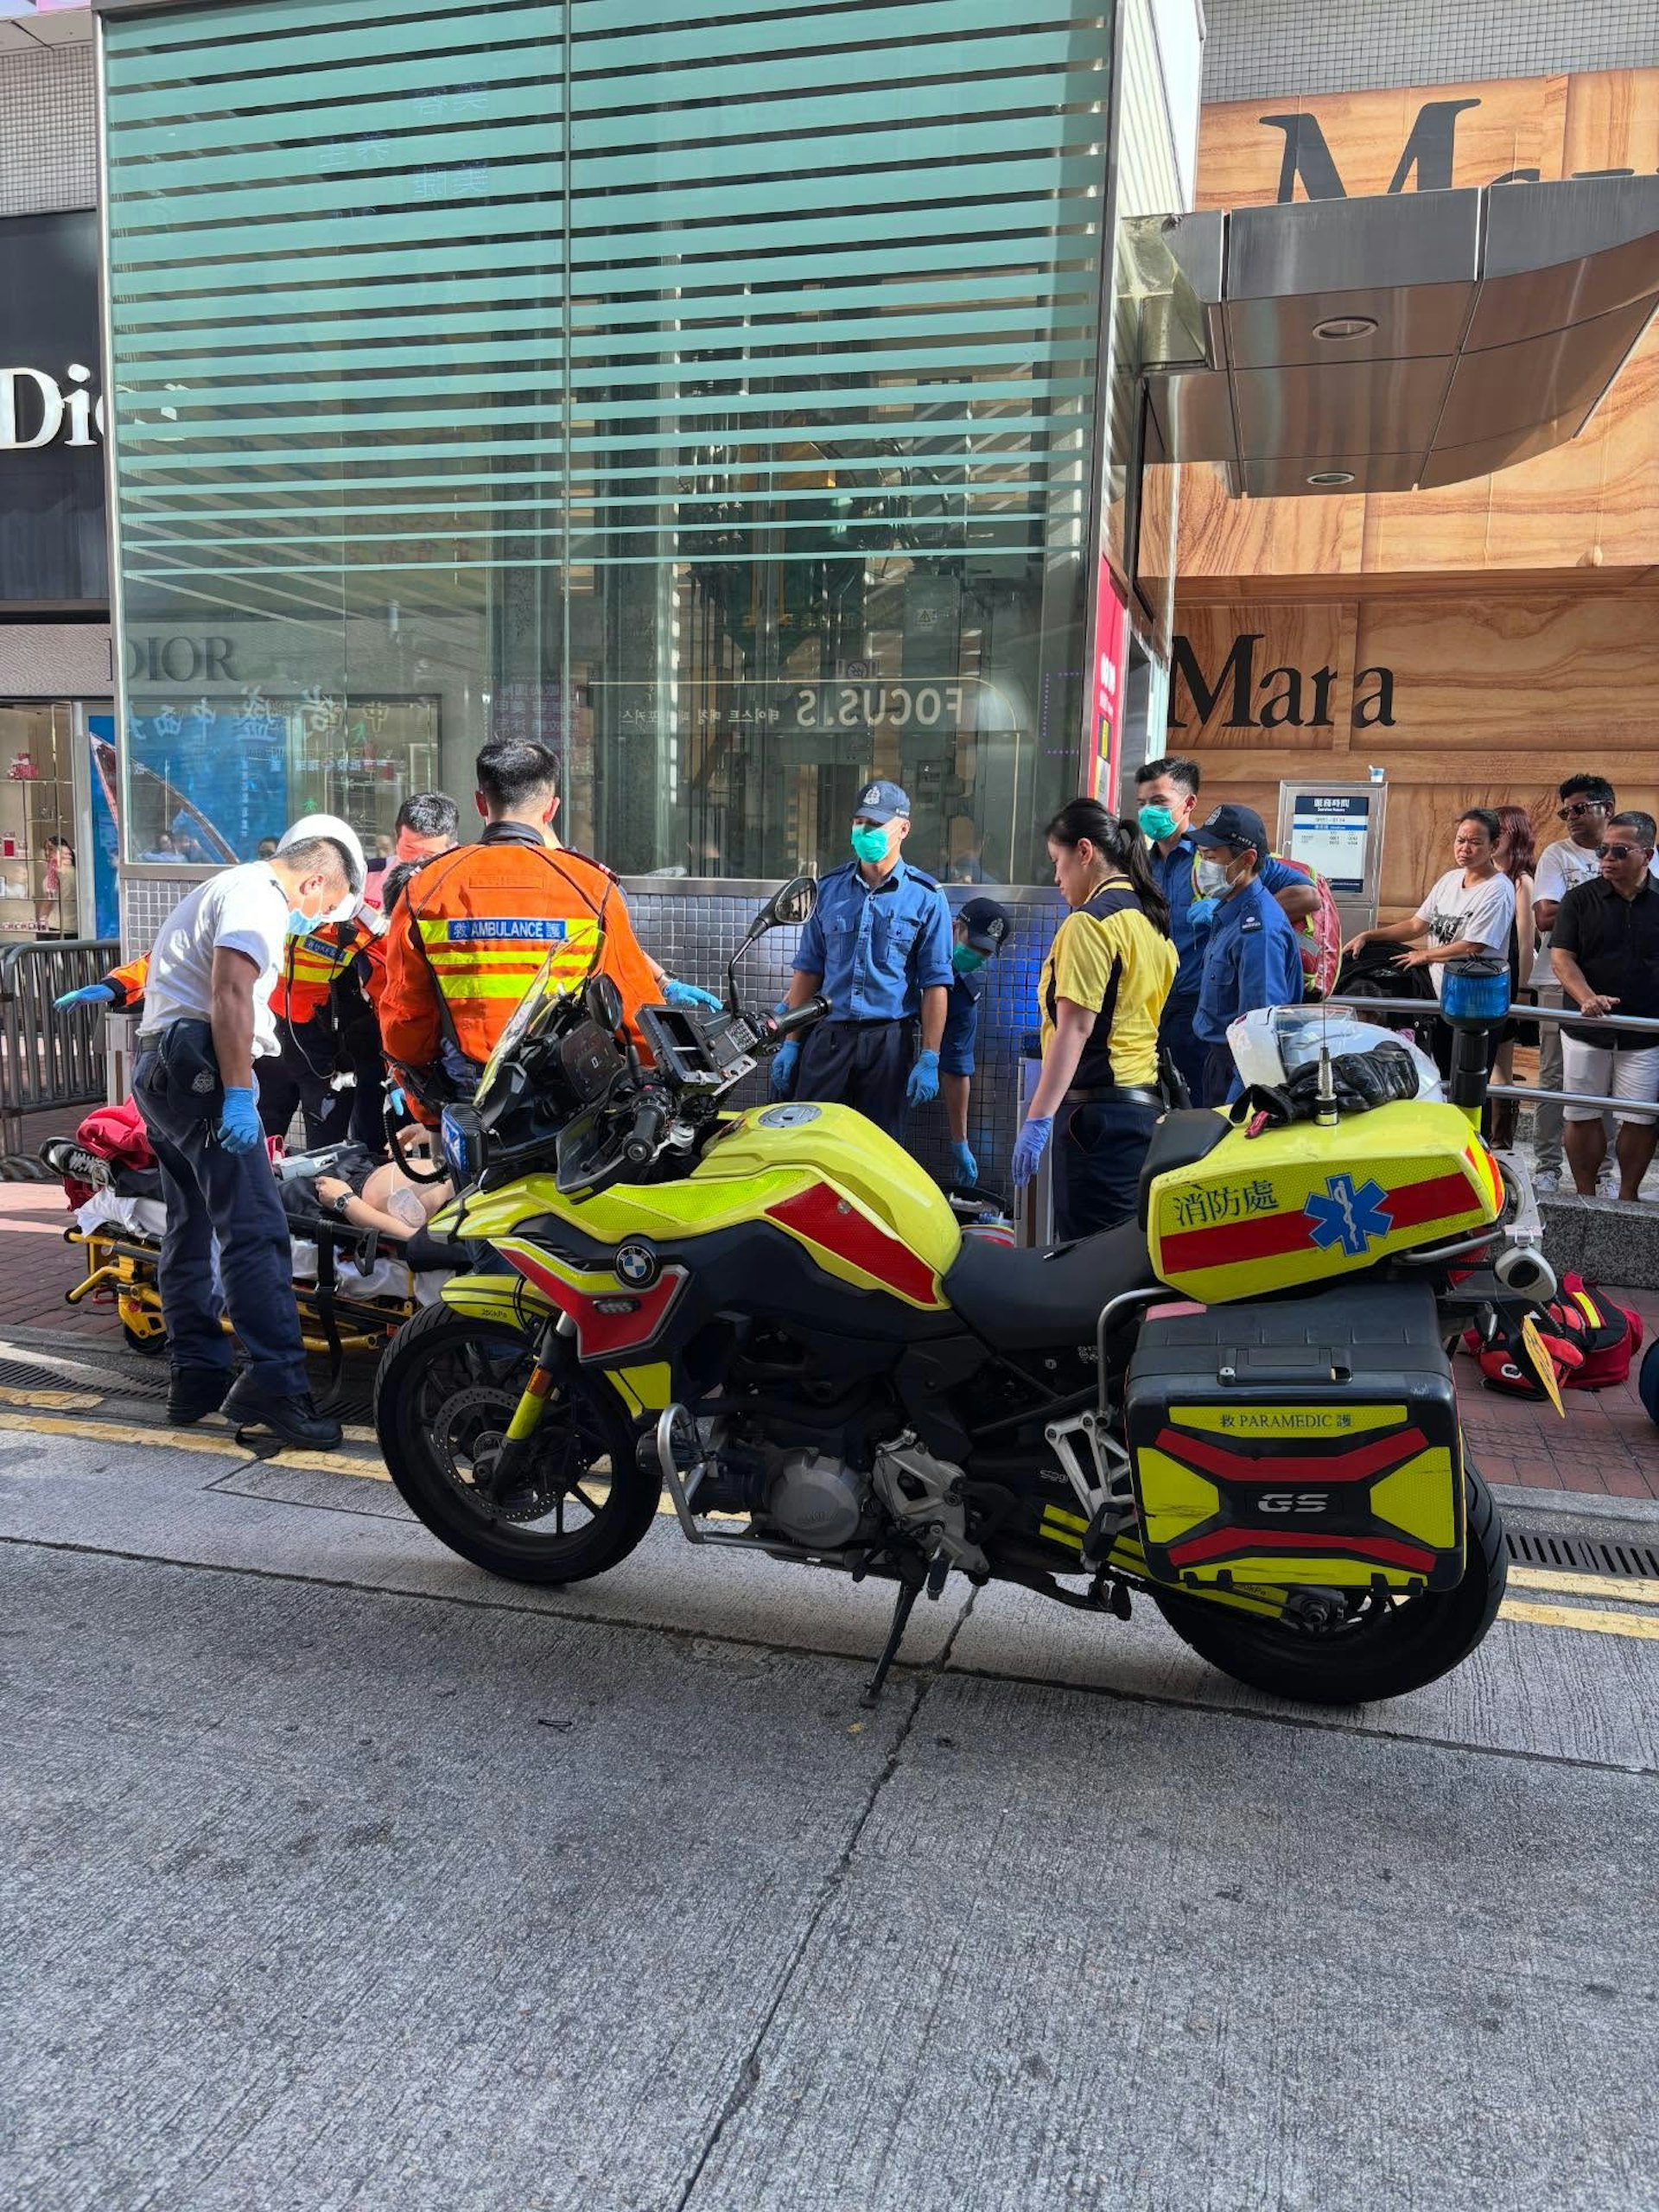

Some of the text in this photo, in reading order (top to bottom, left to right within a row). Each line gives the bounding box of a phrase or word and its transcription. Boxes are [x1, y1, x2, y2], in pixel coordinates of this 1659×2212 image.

[1166, 634, 1396, 728] Mara
[454, 921, 561, 938] 救 AMBULANCE 護
[1173, 1179, 1280, 1226] 消防處
[1220, 1414, 1351, 1427] 救 PARAMEDIC 護
[1257, 1493, 1330, 1513] GS
